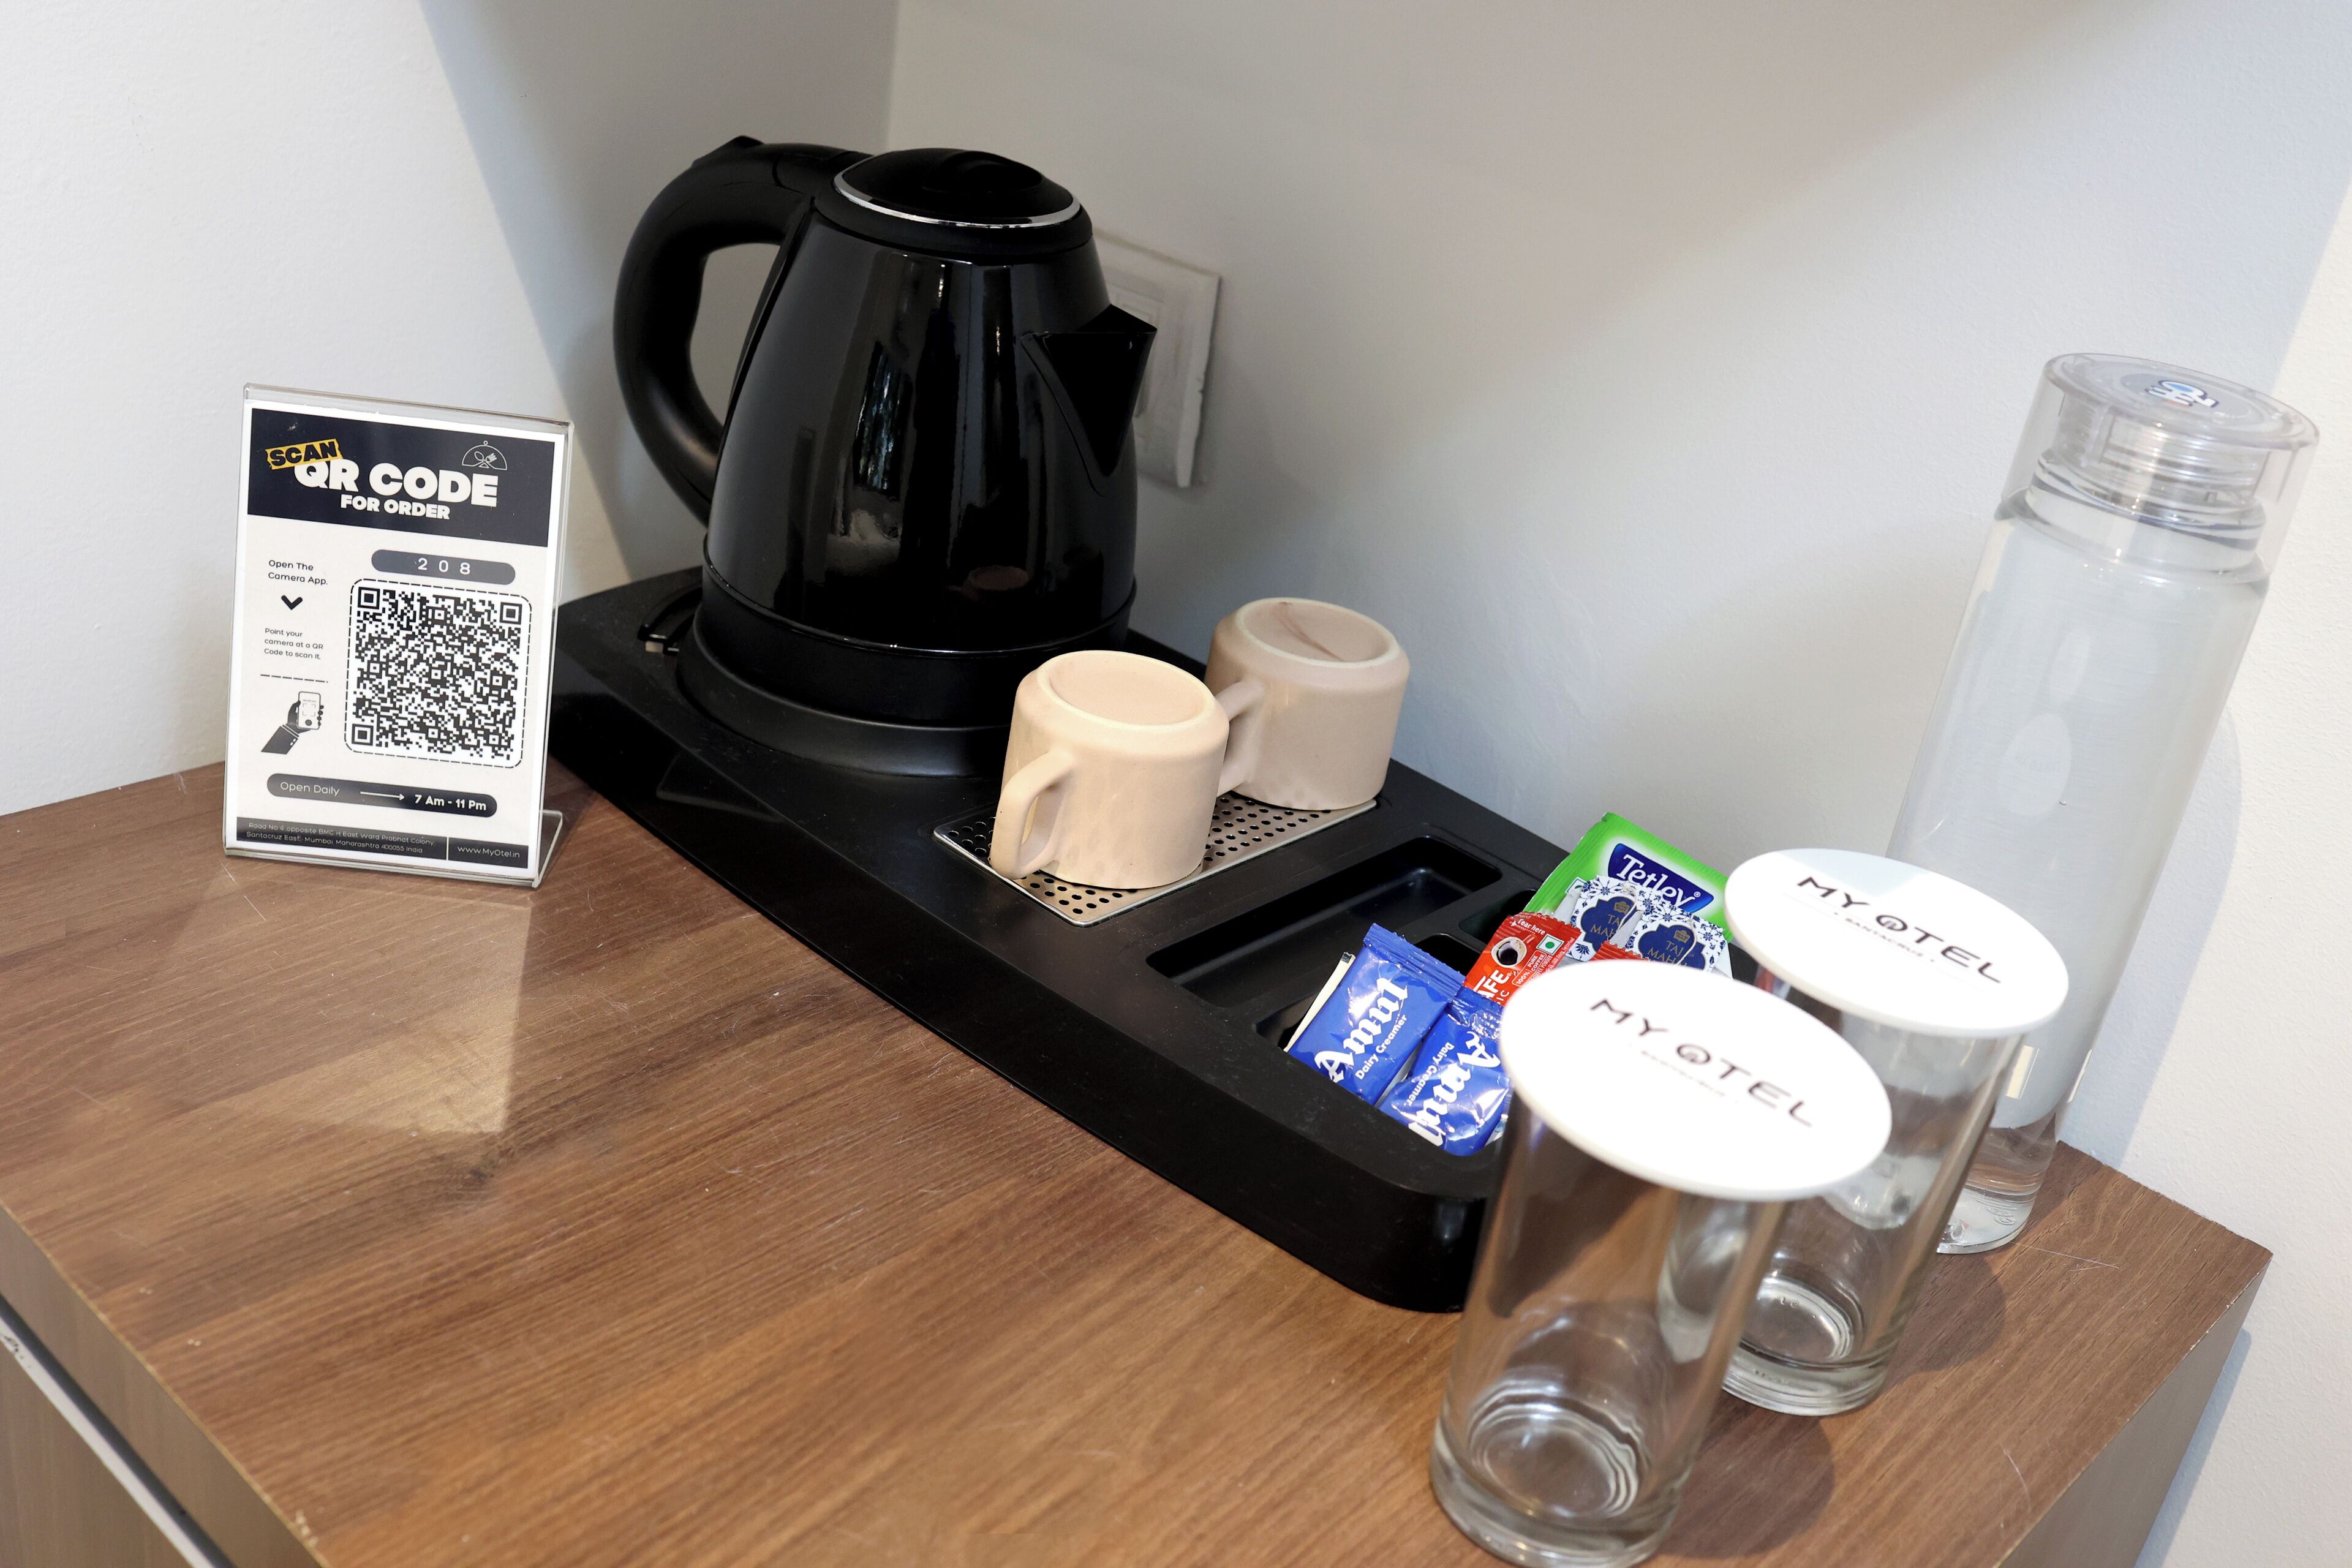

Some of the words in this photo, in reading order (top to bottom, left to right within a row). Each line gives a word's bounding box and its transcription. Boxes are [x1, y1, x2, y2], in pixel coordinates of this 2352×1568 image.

[270, 441, 339, 467] SCAN
[294, 459, 360, 492] QR
[369, 463, 499, 507] CODE
[341, 494, 379, 512] FOR
[383, 500, 451, 520] ORDER
[268, 560, 293, 568] Open
[268, 572, 305, 582] Camera
[308, 576, 328, 586] App.
[281, 782, 310, 793] Open
[314, 785, 340, 796] Daily
[415, 794, 422, 804] 7
[426, 796, 445, 807] Am
[455, 799, 465, 809] 11
[469, 801, 486, 811] Pm
[336, 840, 379, 849] Maharashtra
[1616, 854, 1695, 907] Tetley
[1797, 876, 1870, 908] MY
[1517, 919, 1531, 928] Tear
[1531, 924, 1545, 935] here
[1607, 914, 1623, 927] TA
[1666, 941, 1684, 957] TAJ
[1516, 971, 1531, 984] 100%
[1528, 956, 1538, 967] PURE
[1531, 954, 1545, 971] COFFEE
[1540, 956, 1553, 969] POWDER
[1591, 999, 1668, 1036] MY
[1314, 978, 1408, 1083] Amul
[1355, 1054, 1379, 1080] Dairy
[1376, 1014, 1408, 1054] Creamer
[1433, 1042, 1455, 1065] Dairy
[1408, 1031, 1501, 1146] Amul
